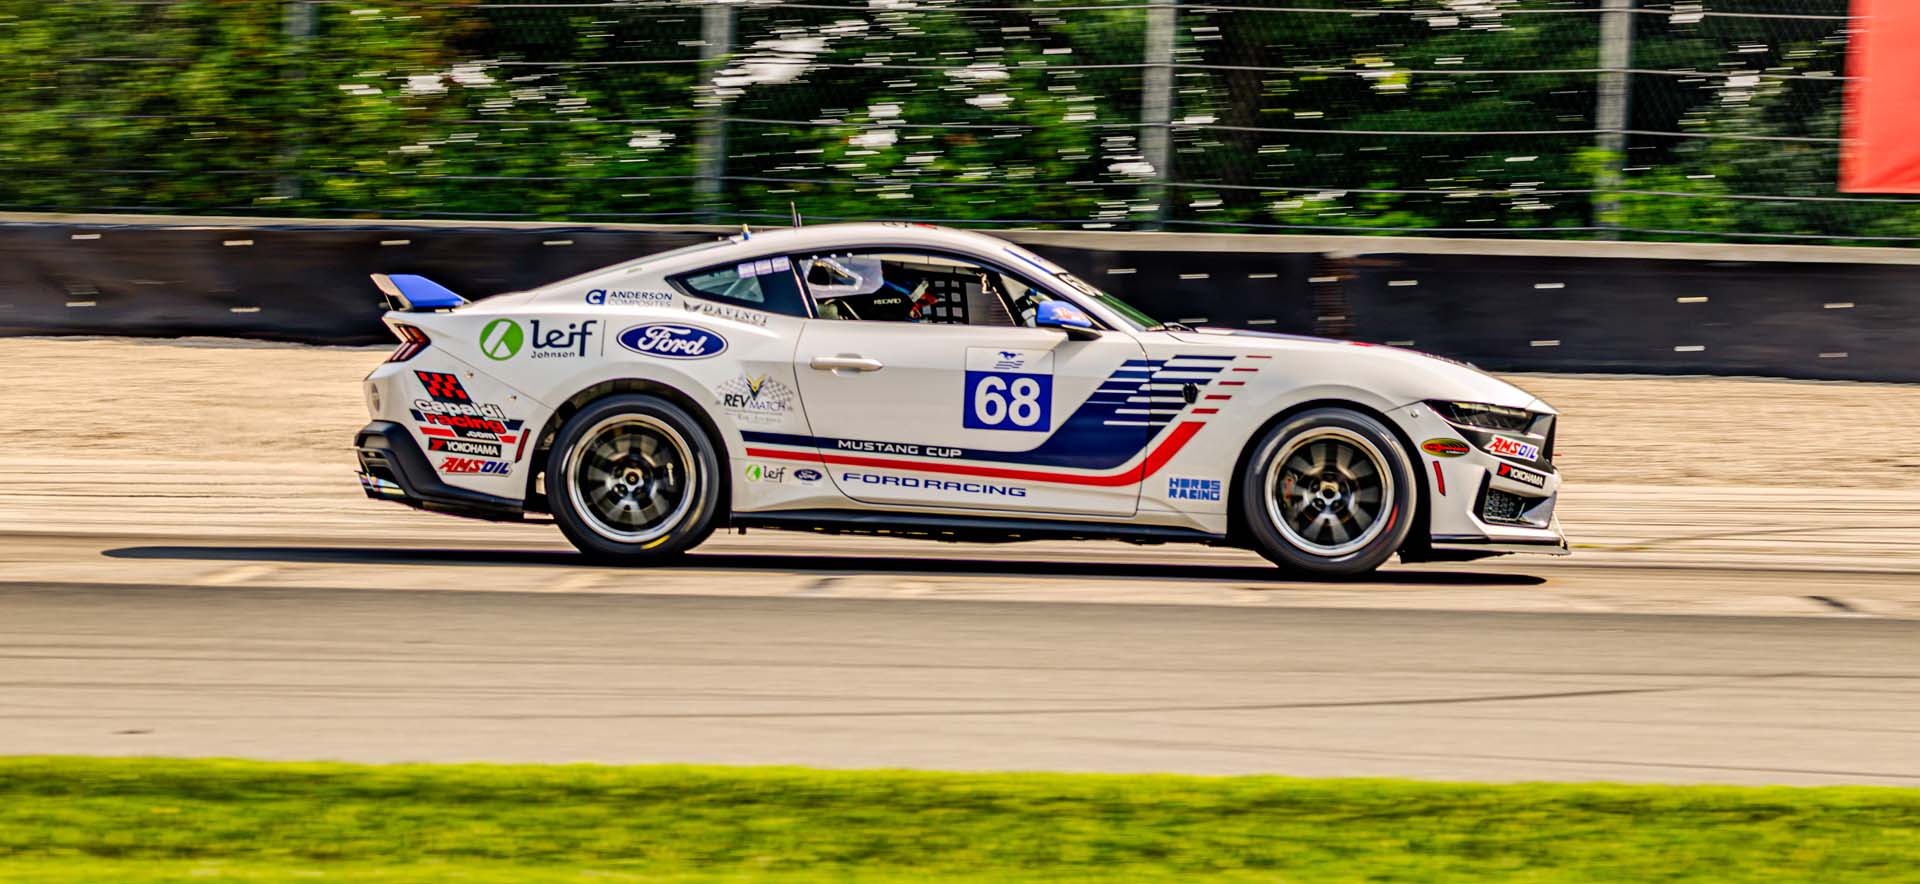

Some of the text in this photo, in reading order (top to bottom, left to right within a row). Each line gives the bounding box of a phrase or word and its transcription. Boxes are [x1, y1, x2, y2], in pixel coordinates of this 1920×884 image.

[610, 291, 672, 300] ANDERSON
[530, 320, 598, 357] leif
[637, 326, 708, 355] Ford
[531, 351, 575, 359] Johnson
[414, 399, 506, 419] capaldi
[974, 375, 1041, 427] 68
[424, 412, 507, 434] racing
[446, 440, 499, 456] YOKOHAMA
[838, 440, 962, 458] MUSTANG CUP
[1488, 437, 1537, 460] AMSOIL
[439, 456, 509, 474] AMSOIL
[843, 472, 1027, 497] FORD RACING
[1510, 469, 1544, 486] YOKOHAMA
[1168, 488, 1220, 501] RACING
